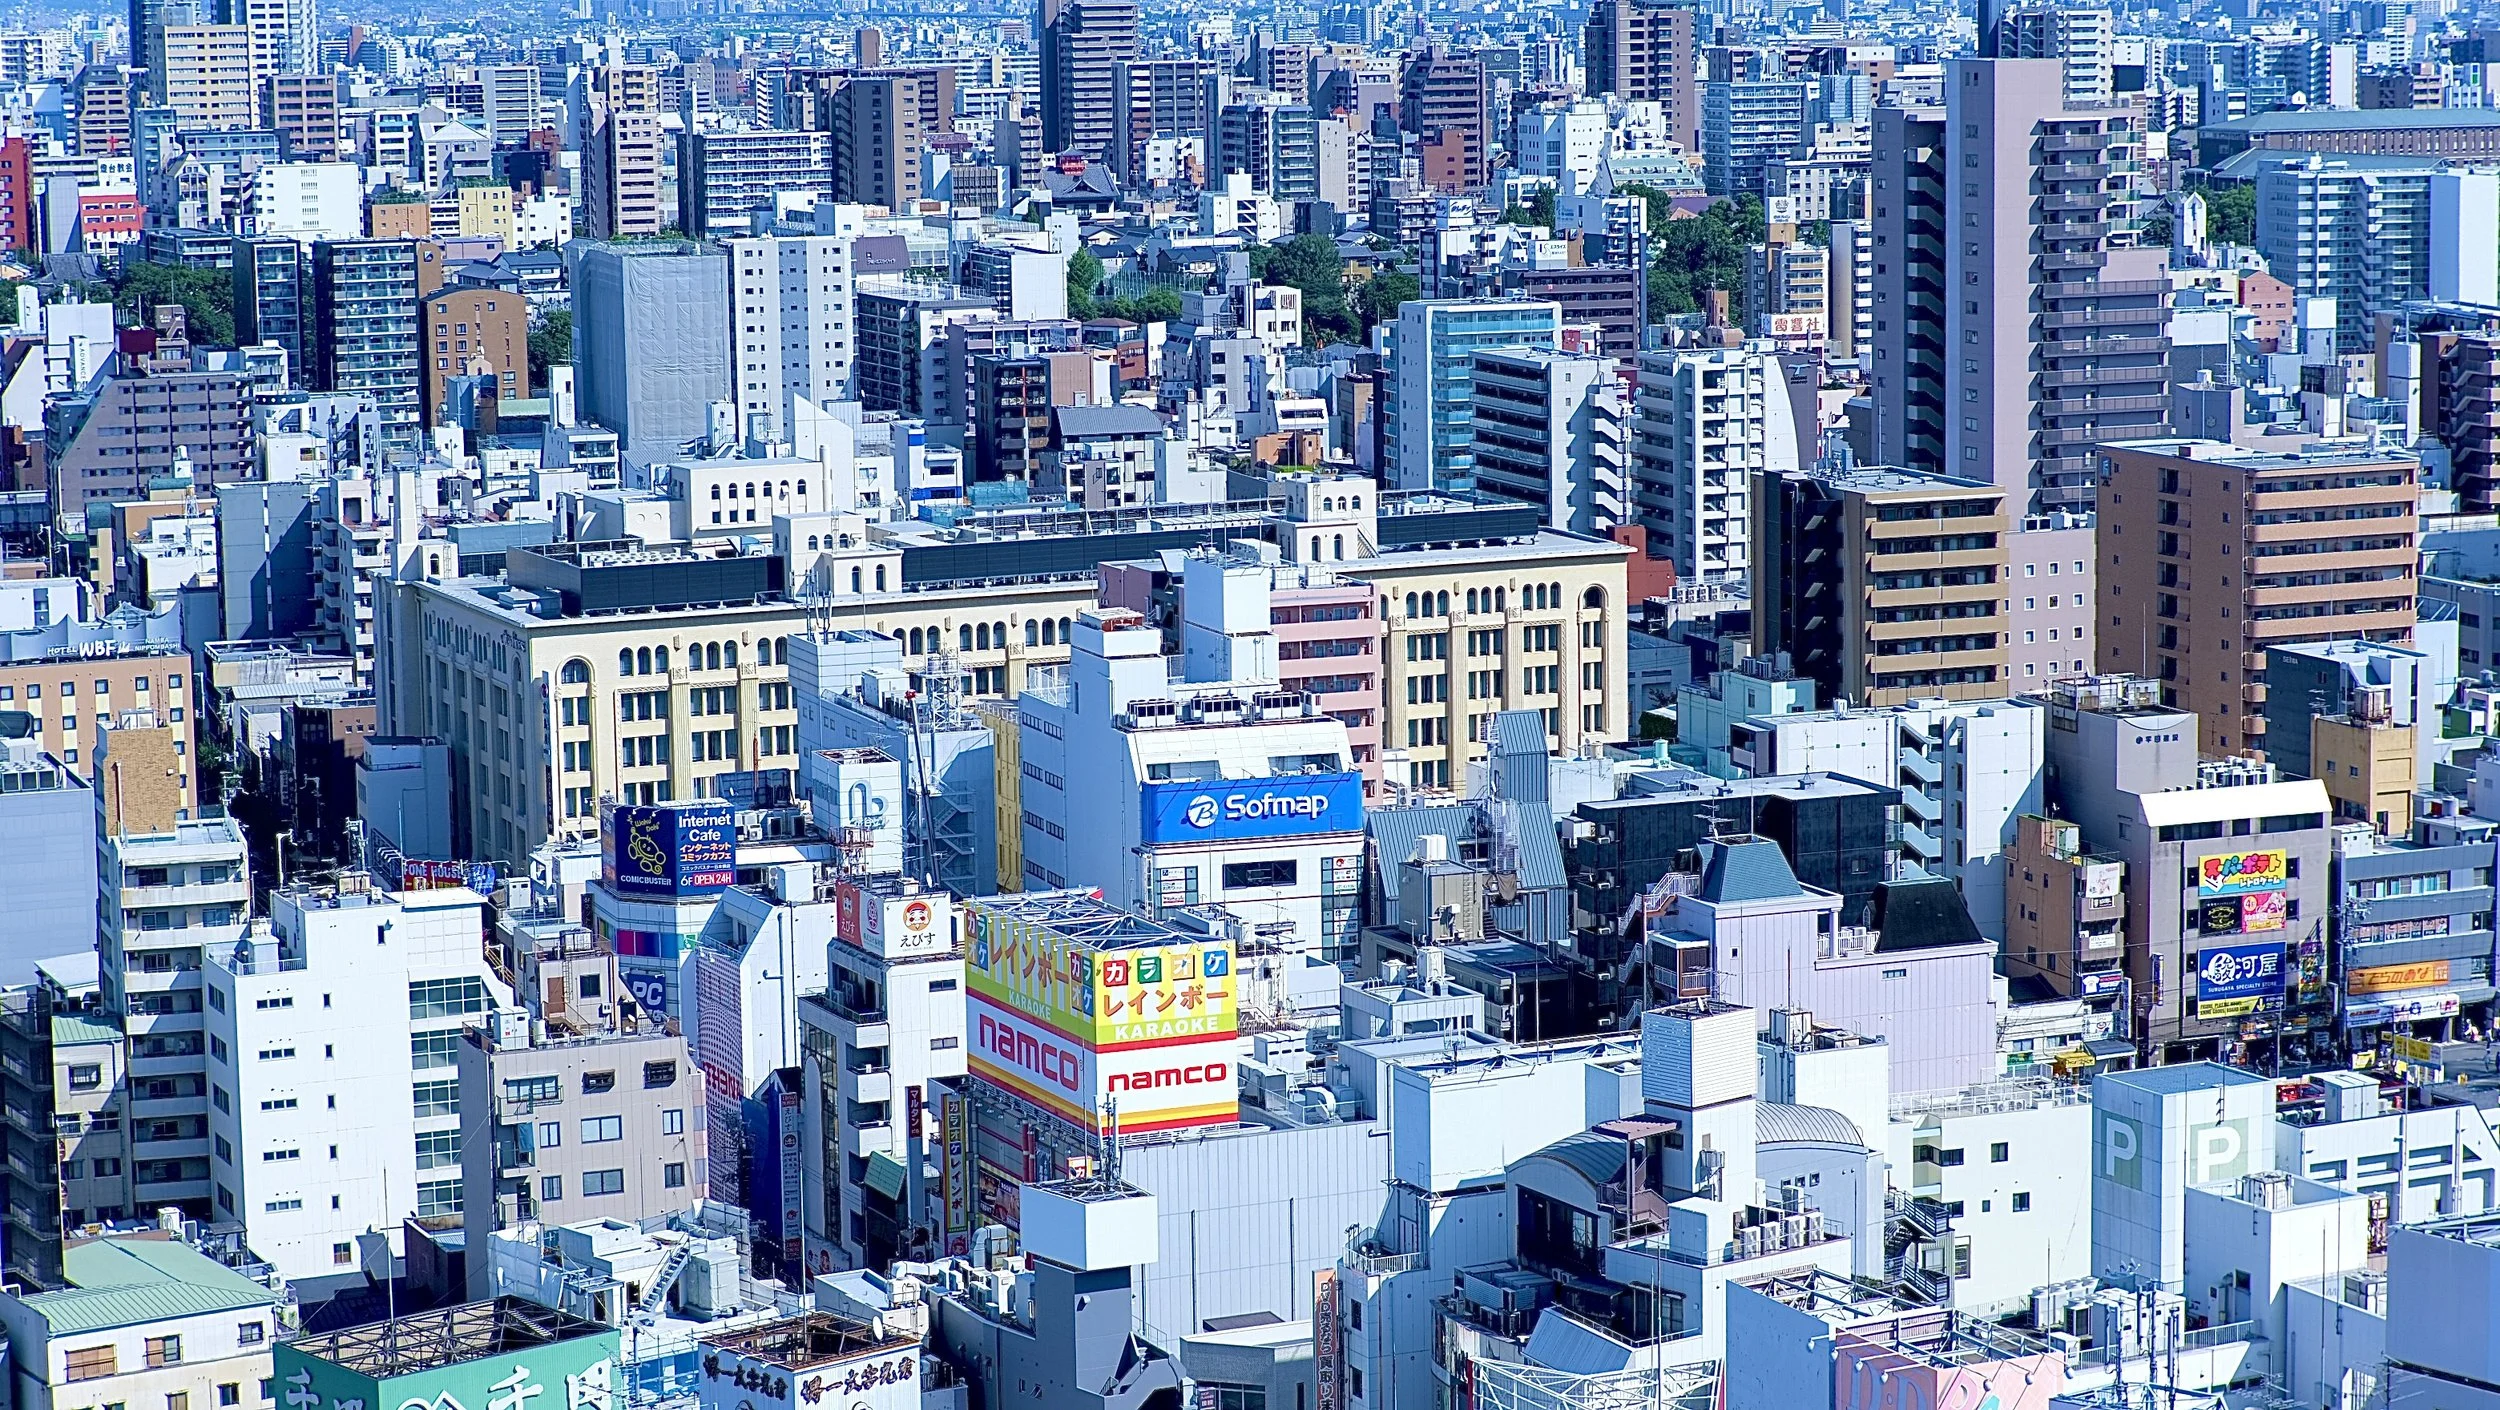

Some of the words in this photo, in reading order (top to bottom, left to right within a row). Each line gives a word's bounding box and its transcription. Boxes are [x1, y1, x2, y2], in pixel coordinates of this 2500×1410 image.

[47, 646, 77, 656] HOTEL
[79, 639, 116, 658] WBF
[1226, 792, 1328, 819] Sofmap
[679, 814, 732, 828] Internet
[689, 828, 721, 841] Cafe
[680, 842, 731, 853] インターネット
[680, 852, 731, 862] コミックカフェ
[681, 875, 693, 886] 6F
[694, 874, 715, 886] OPEN
[716, 872, 732, 884] 24H
[2239, 875, 2280, 888] レトロゲーム
[841, 918, 855, 935] えびす
[900, 932, 936, 948] えびす
[989, 931, 1070, 988] レインボー
[1104, 952, 1226, 985] カラオケ
[2209, 953, 2279, 984] 駿河屋
[1009, 989, 1052, 1021] KARAOKE
[1103, 983, 1229, 1018] レインボー
[1115, 1016, 1219, 1041] KARAOKE
[979, 1013, 1079, 1093] namco
[1108, 1062, 1227, 1092] namco
[910, 1089, 920, 1127] マルタン
[2106, 1117, 2137, 1177] P
[2197, 1126, 2241, 1184] P
